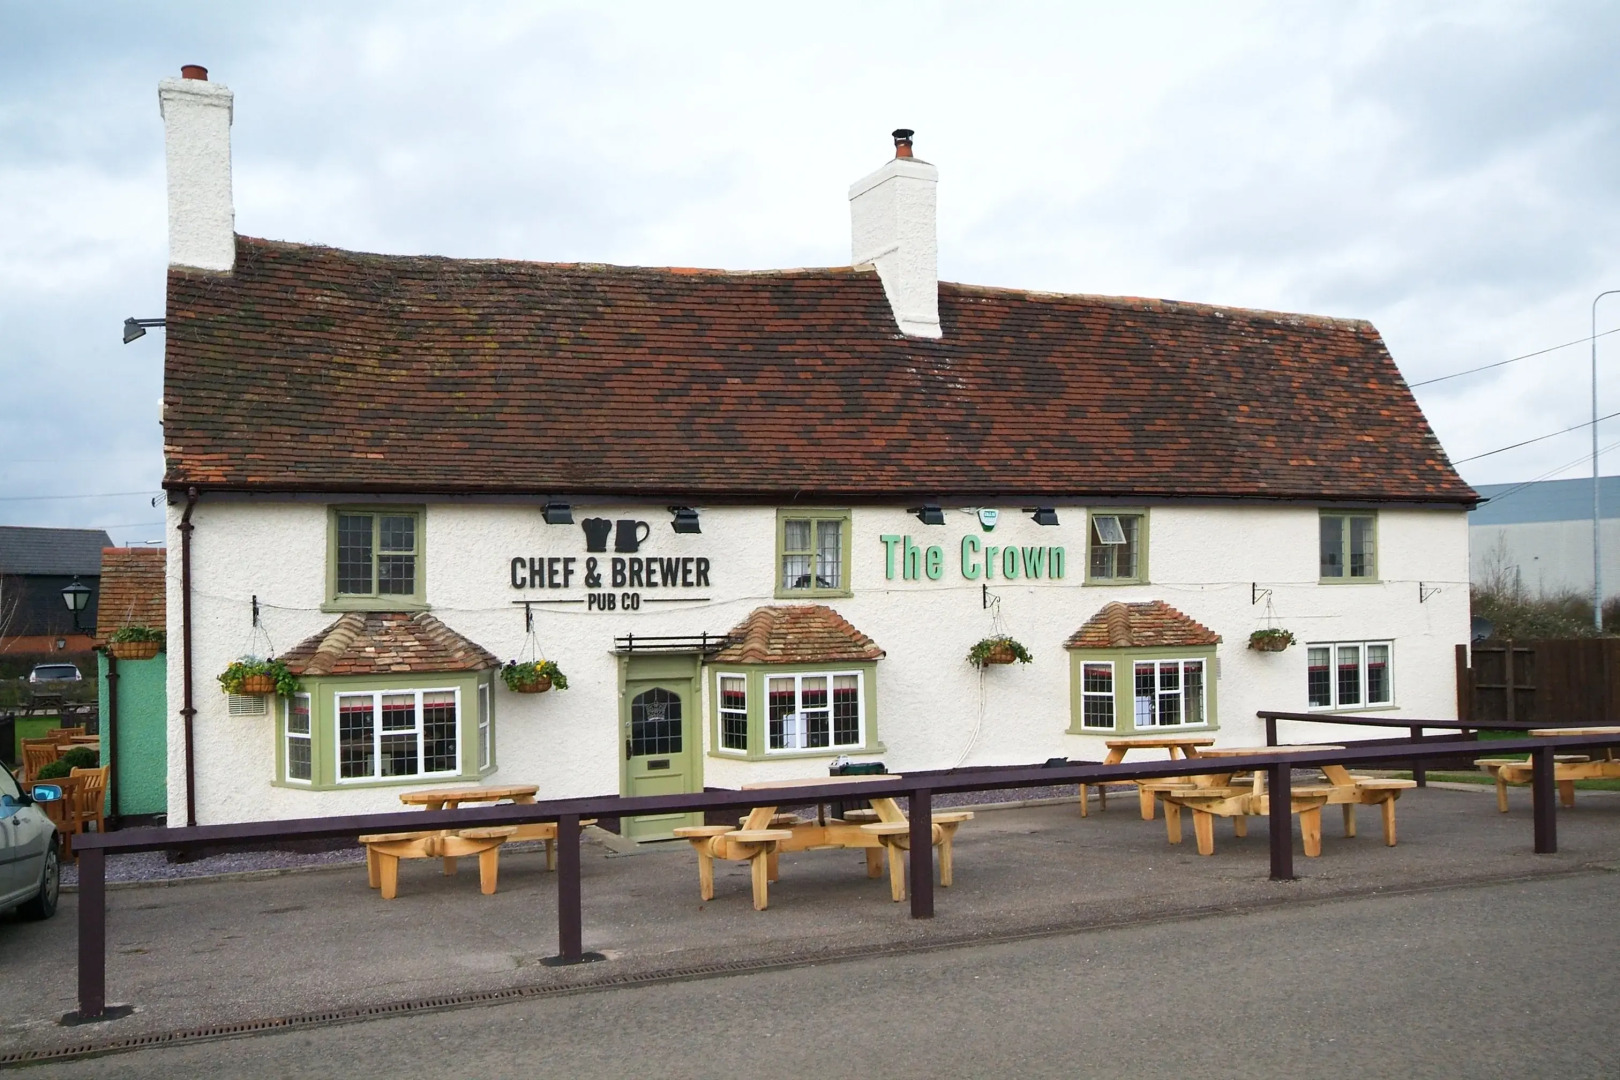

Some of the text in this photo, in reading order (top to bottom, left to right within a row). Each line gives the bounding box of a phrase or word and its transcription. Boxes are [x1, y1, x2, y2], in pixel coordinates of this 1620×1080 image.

[511, 557, 710, 589] CHEF & BREWER
[880, 534, 1066, 580] The Crown
[588, 592, 640, 611] PUB CO
